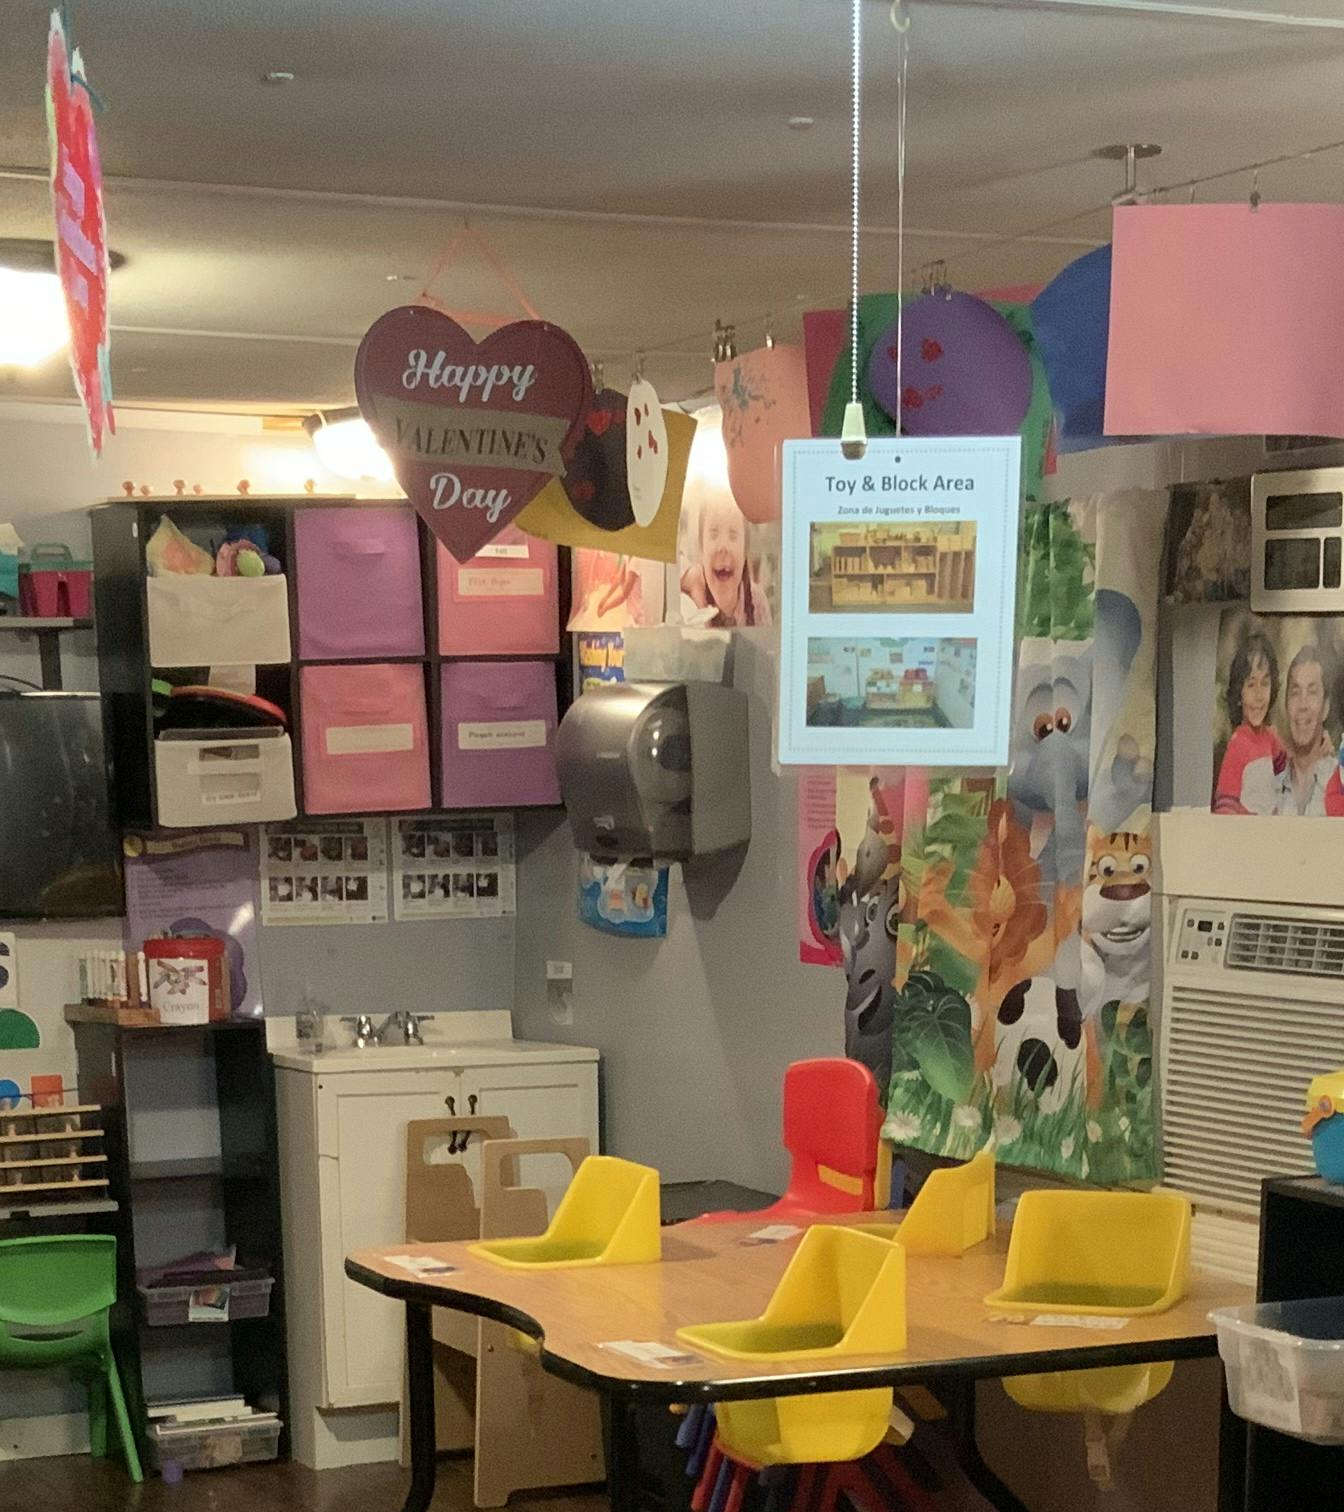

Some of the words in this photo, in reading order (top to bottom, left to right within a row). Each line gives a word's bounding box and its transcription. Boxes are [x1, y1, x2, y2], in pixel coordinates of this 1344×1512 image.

[402, 349, 535, 402] Happy
[396, 418, 548, 464] VALENTINE'S
[430, 472, 511, 523] Day
[825, 476, 857, 496] Toy
[862, 475, 876, 492] &
[882, 475, 928, 492] Block
[933, 475, 975, 492] Area
[838, 506, 860, 515] Zona
[862, 506, 873, 515] de
[875, 505, 913, 518] Juguetes
[916, 508, 923, 517] y
[924, 505, 961, 517] Bloques
